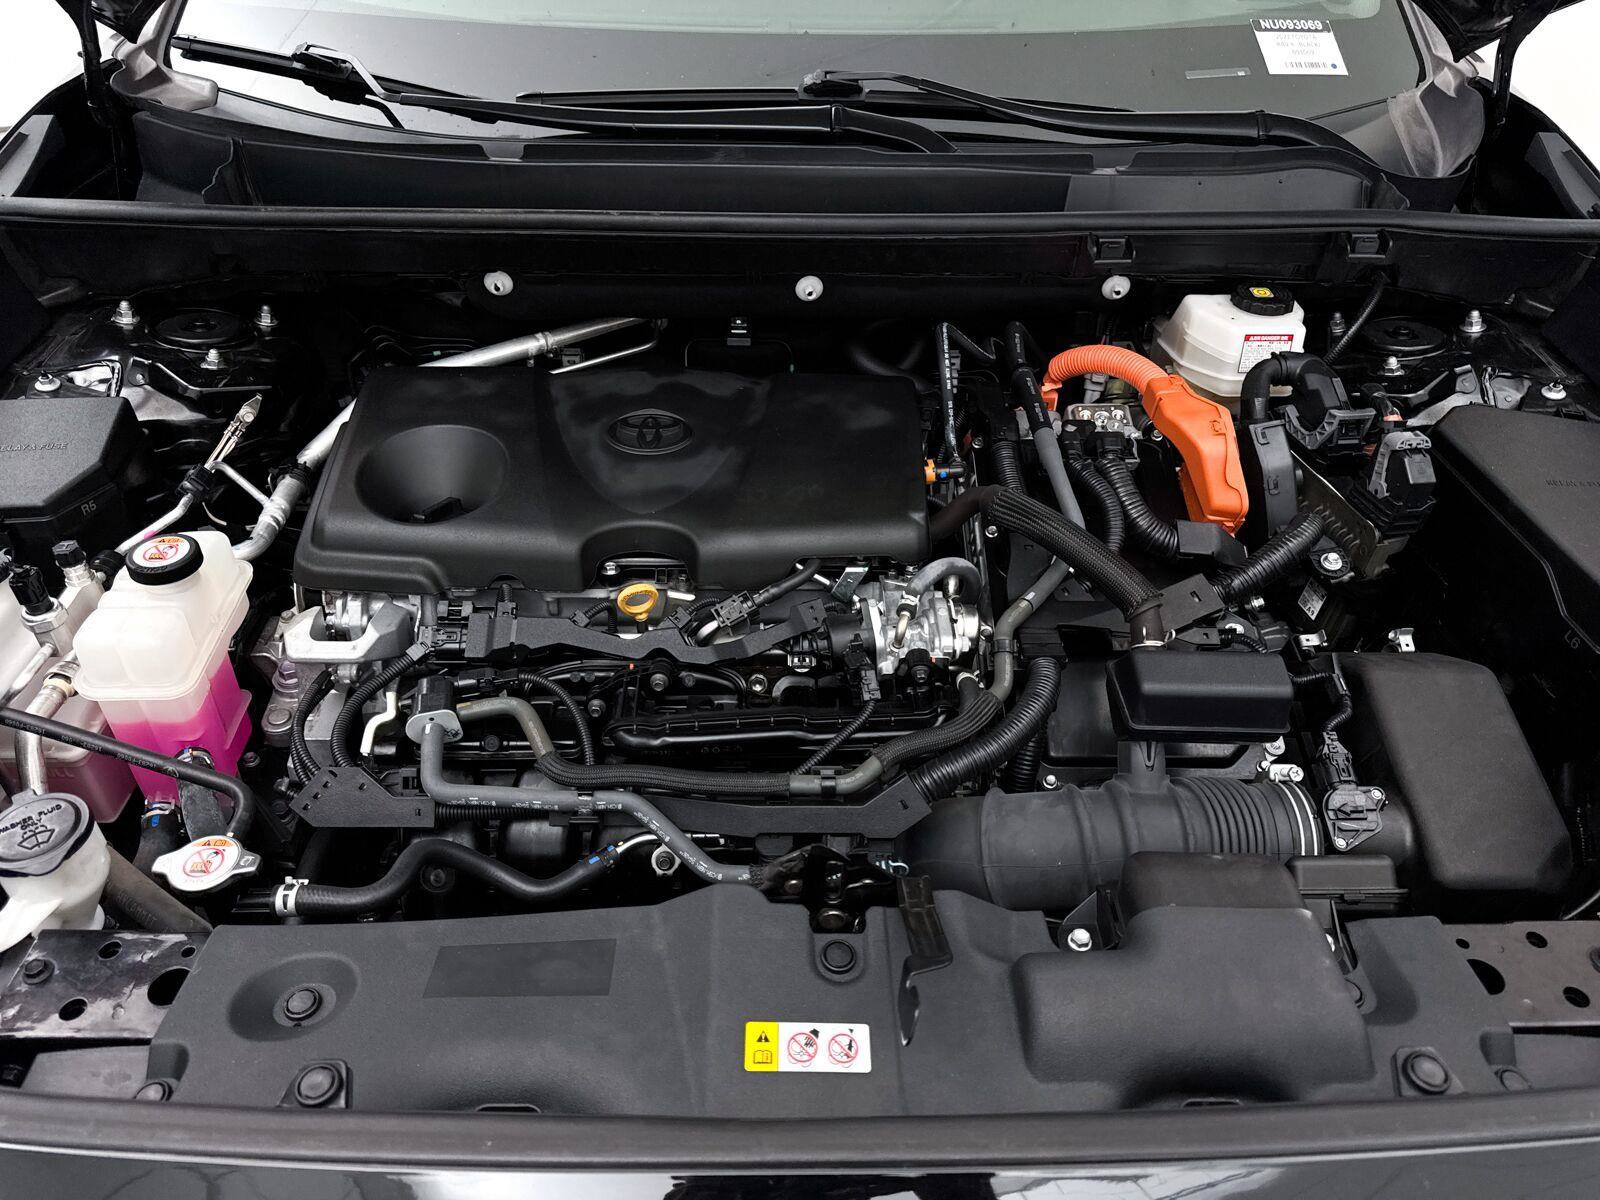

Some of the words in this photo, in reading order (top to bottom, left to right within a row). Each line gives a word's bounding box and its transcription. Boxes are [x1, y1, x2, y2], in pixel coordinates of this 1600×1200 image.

[1259, 19, 1323, 30] NU093069
[37, 803, 62, 817] FLUID
[20, 818, 42, 831] ONLY
